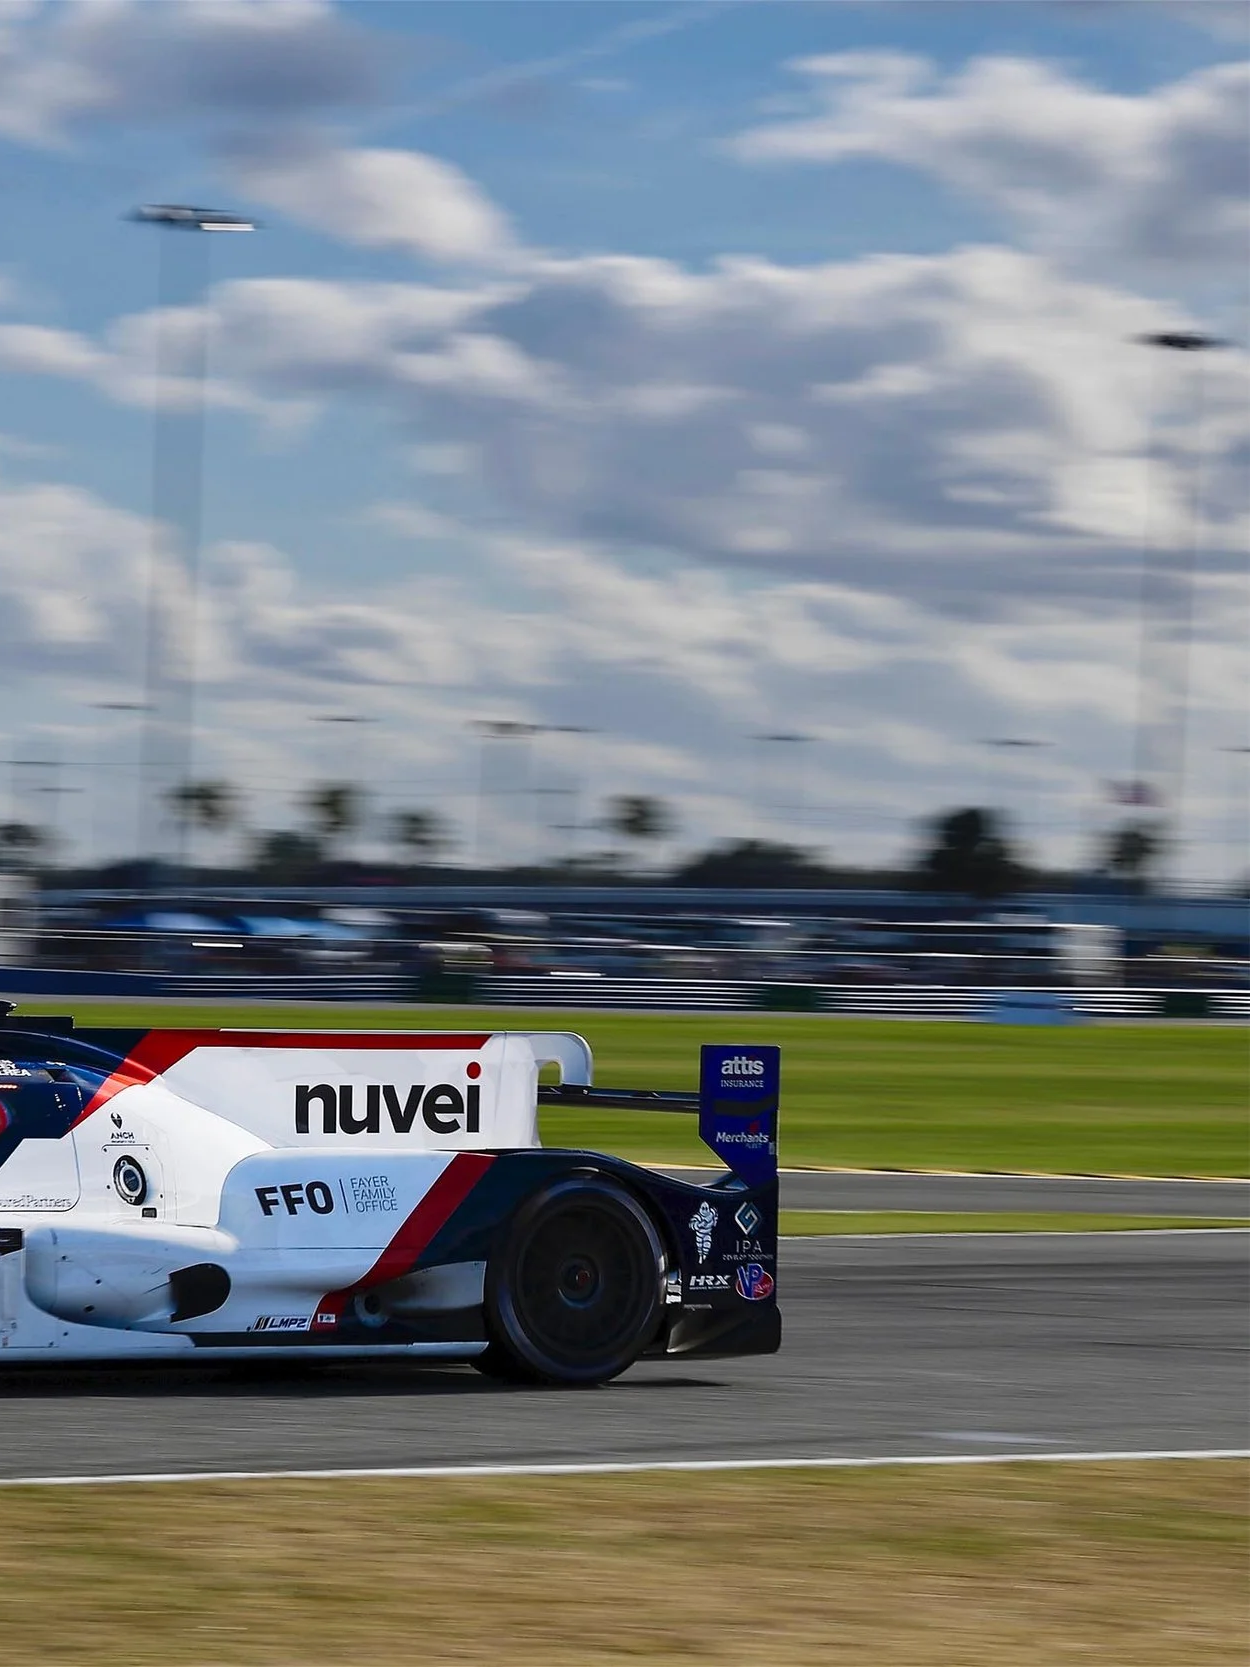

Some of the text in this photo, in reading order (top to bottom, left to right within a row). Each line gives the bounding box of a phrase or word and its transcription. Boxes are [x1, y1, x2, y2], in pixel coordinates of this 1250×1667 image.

[721, 1056, 764, 1075] attis
[720, 1079, 764, 1088] INSURANCE
[295, 1061, 481, 1134] nuvei
[110, 1131, 135, 1140] ANCH
[716, 1131, 769, 1143] Merchants
[350, 1175, 389, 1189] FAYER
[254, 1181, 334, 1216] FFO
[353, 1187, 396, 1200] FAMILY
[355, 1199, 398, 1213] OFFICE
[735, 1240, 763, 1253] IPA
[689, 1275, 731, 1286] HRX
[269, 1317, 308, 1329] LMP2
